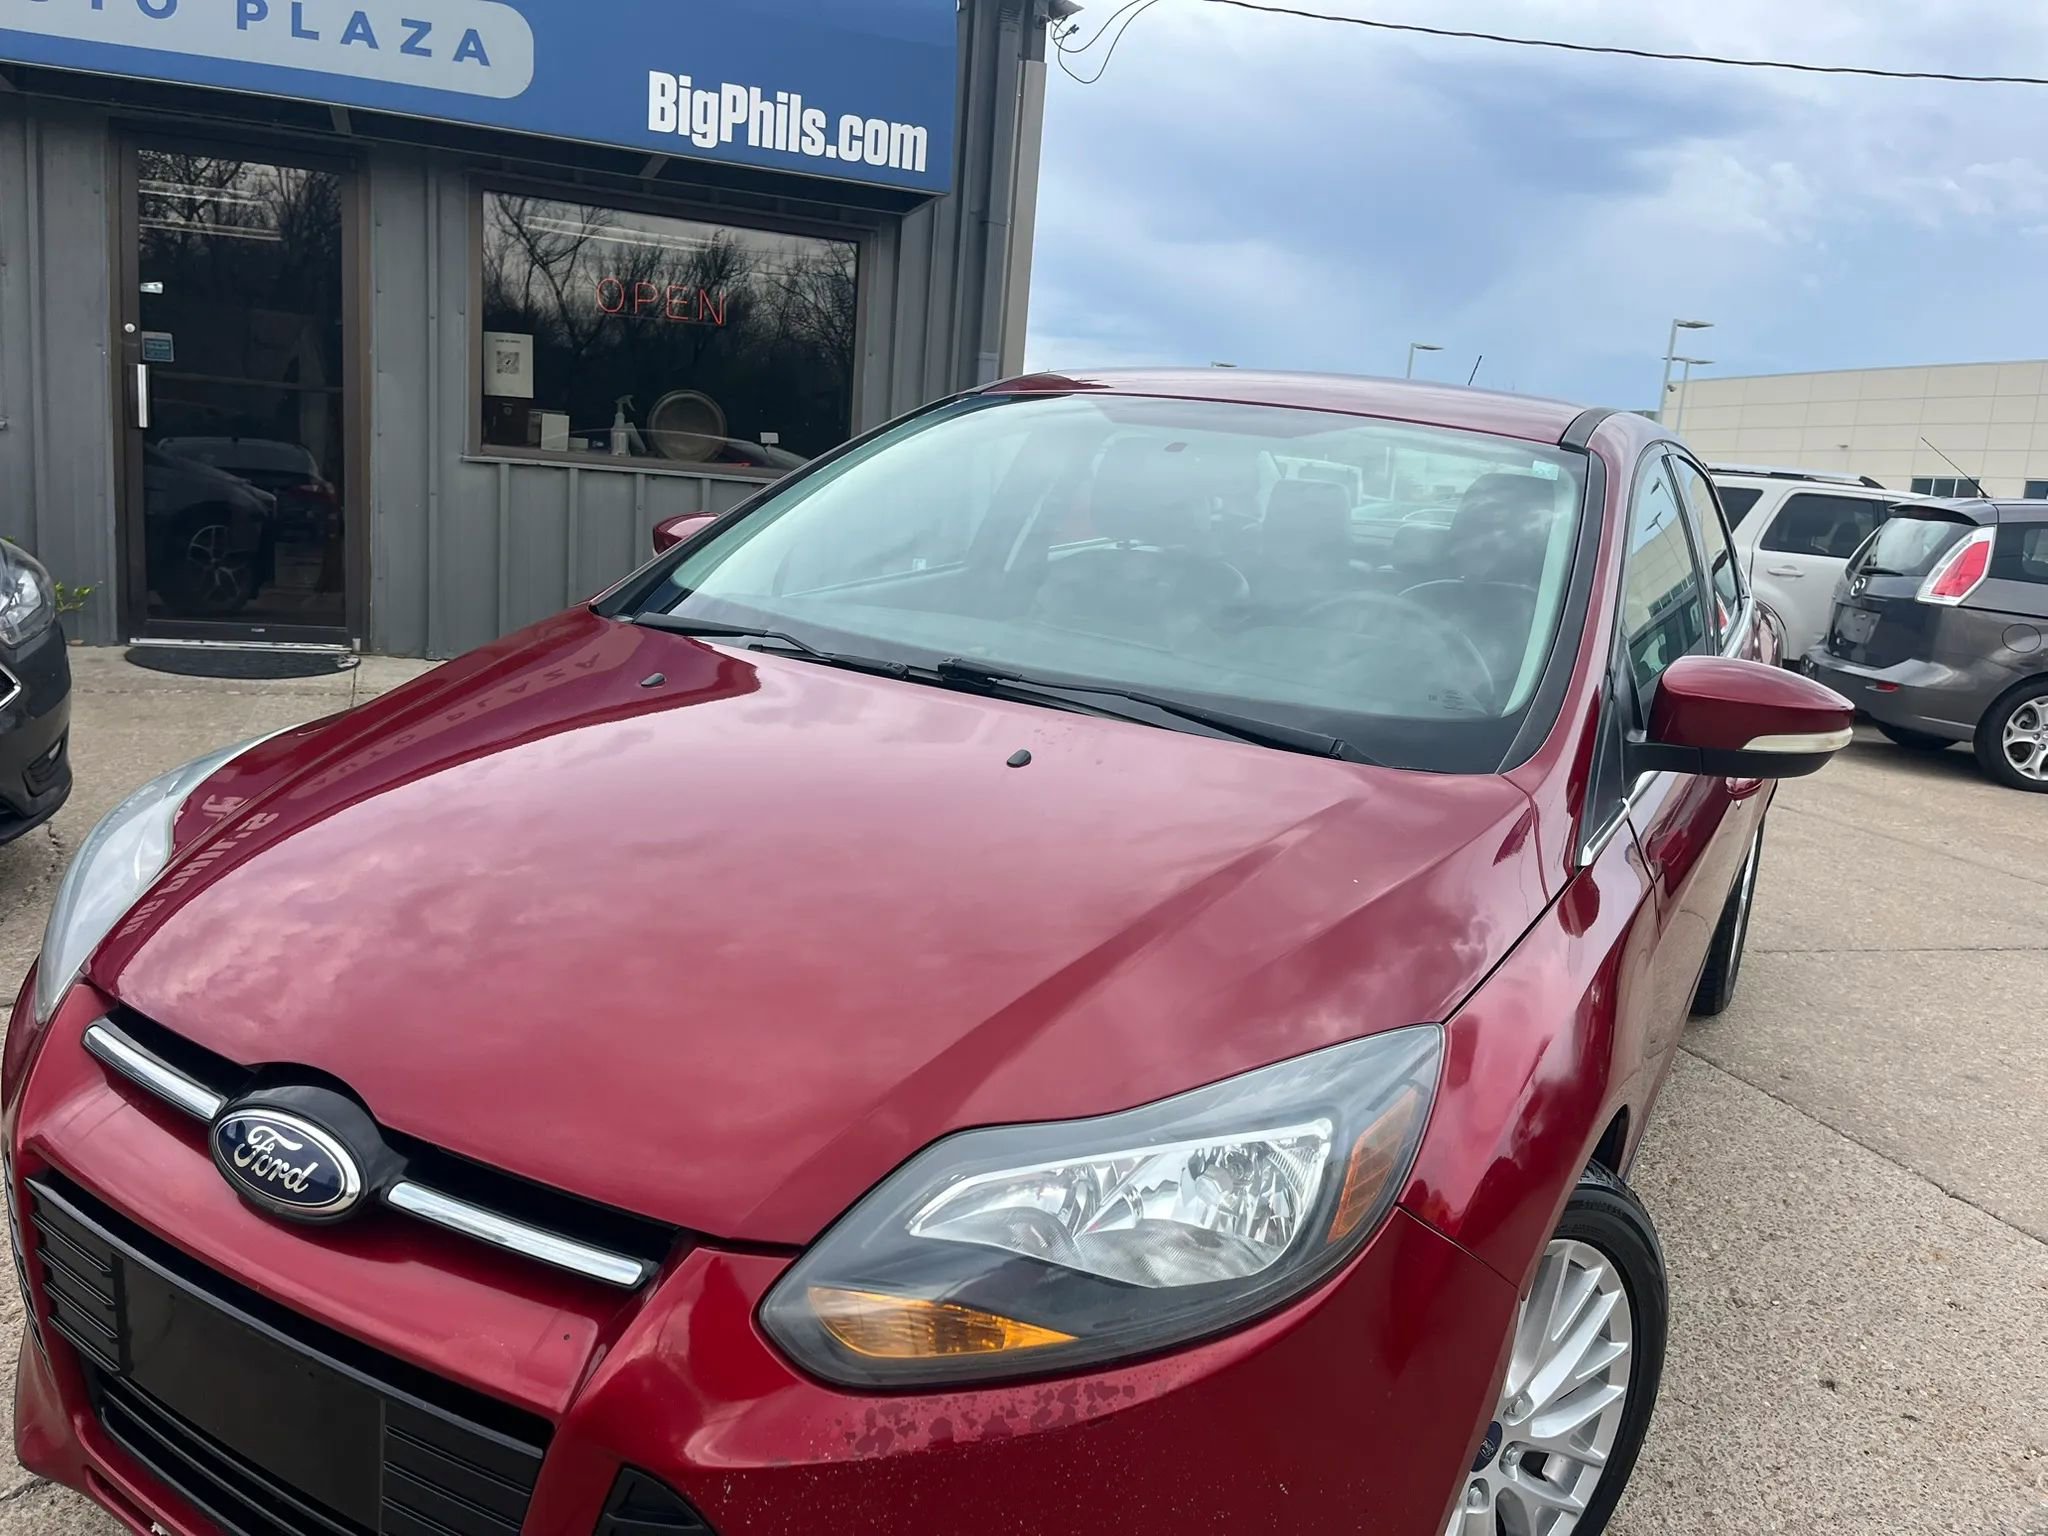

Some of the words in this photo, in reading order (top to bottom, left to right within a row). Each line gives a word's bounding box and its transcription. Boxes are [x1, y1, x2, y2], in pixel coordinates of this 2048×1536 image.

[236, 0, 491, 67] PLAZA
[648, 70, 928, 172] BigPhils.com
[596, 277, 726, 325] OPEN
[233, 1125, 319, 1194] Ford
